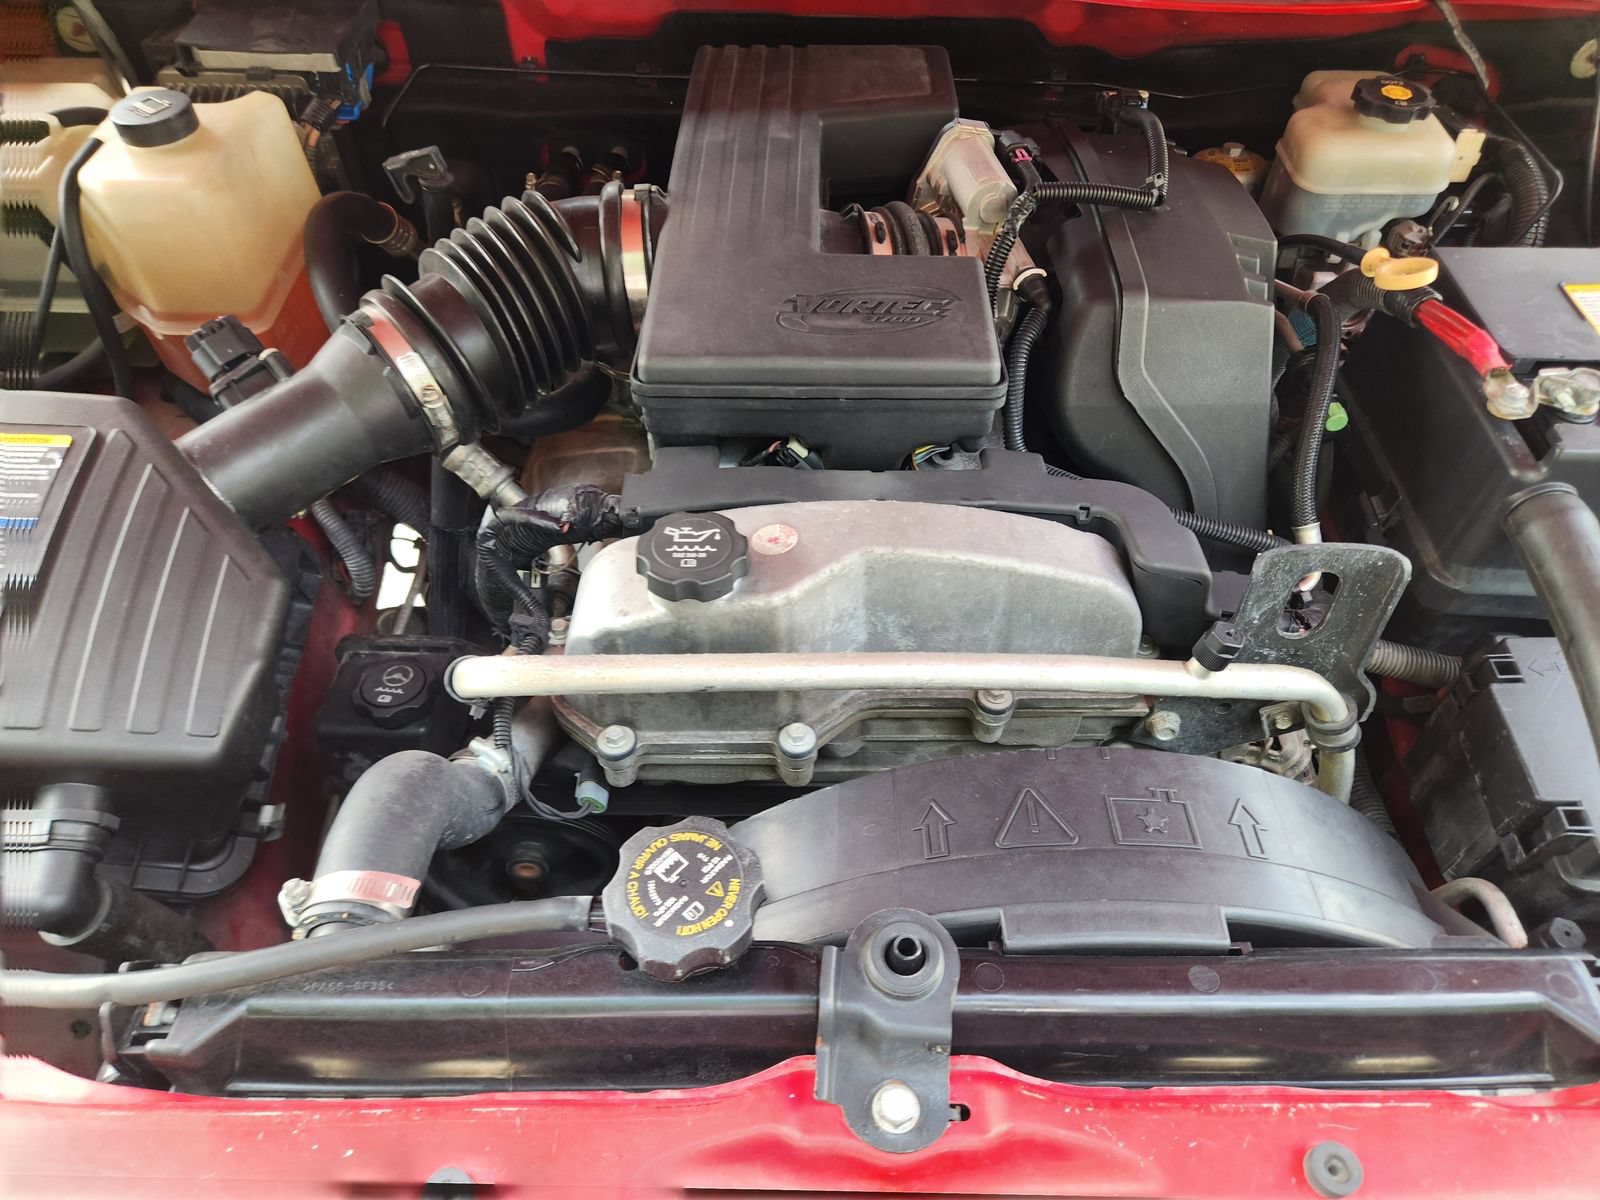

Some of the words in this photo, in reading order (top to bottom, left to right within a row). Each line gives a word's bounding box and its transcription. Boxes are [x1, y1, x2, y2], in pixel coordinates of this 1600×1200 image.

[669, 831, 707, 843] JAMAIS
[632, 838, 669, 870] OUVRIR
[628, 871, 640, 879] A
[699, 854, 734, 884] RADIATOR
[626, 881, 649, 919] CHAUD!
[723, 878, 741, 910] NEVER
[676, 924, 703, 936] HOT!
[702, 908, 729, 930] OPEN
